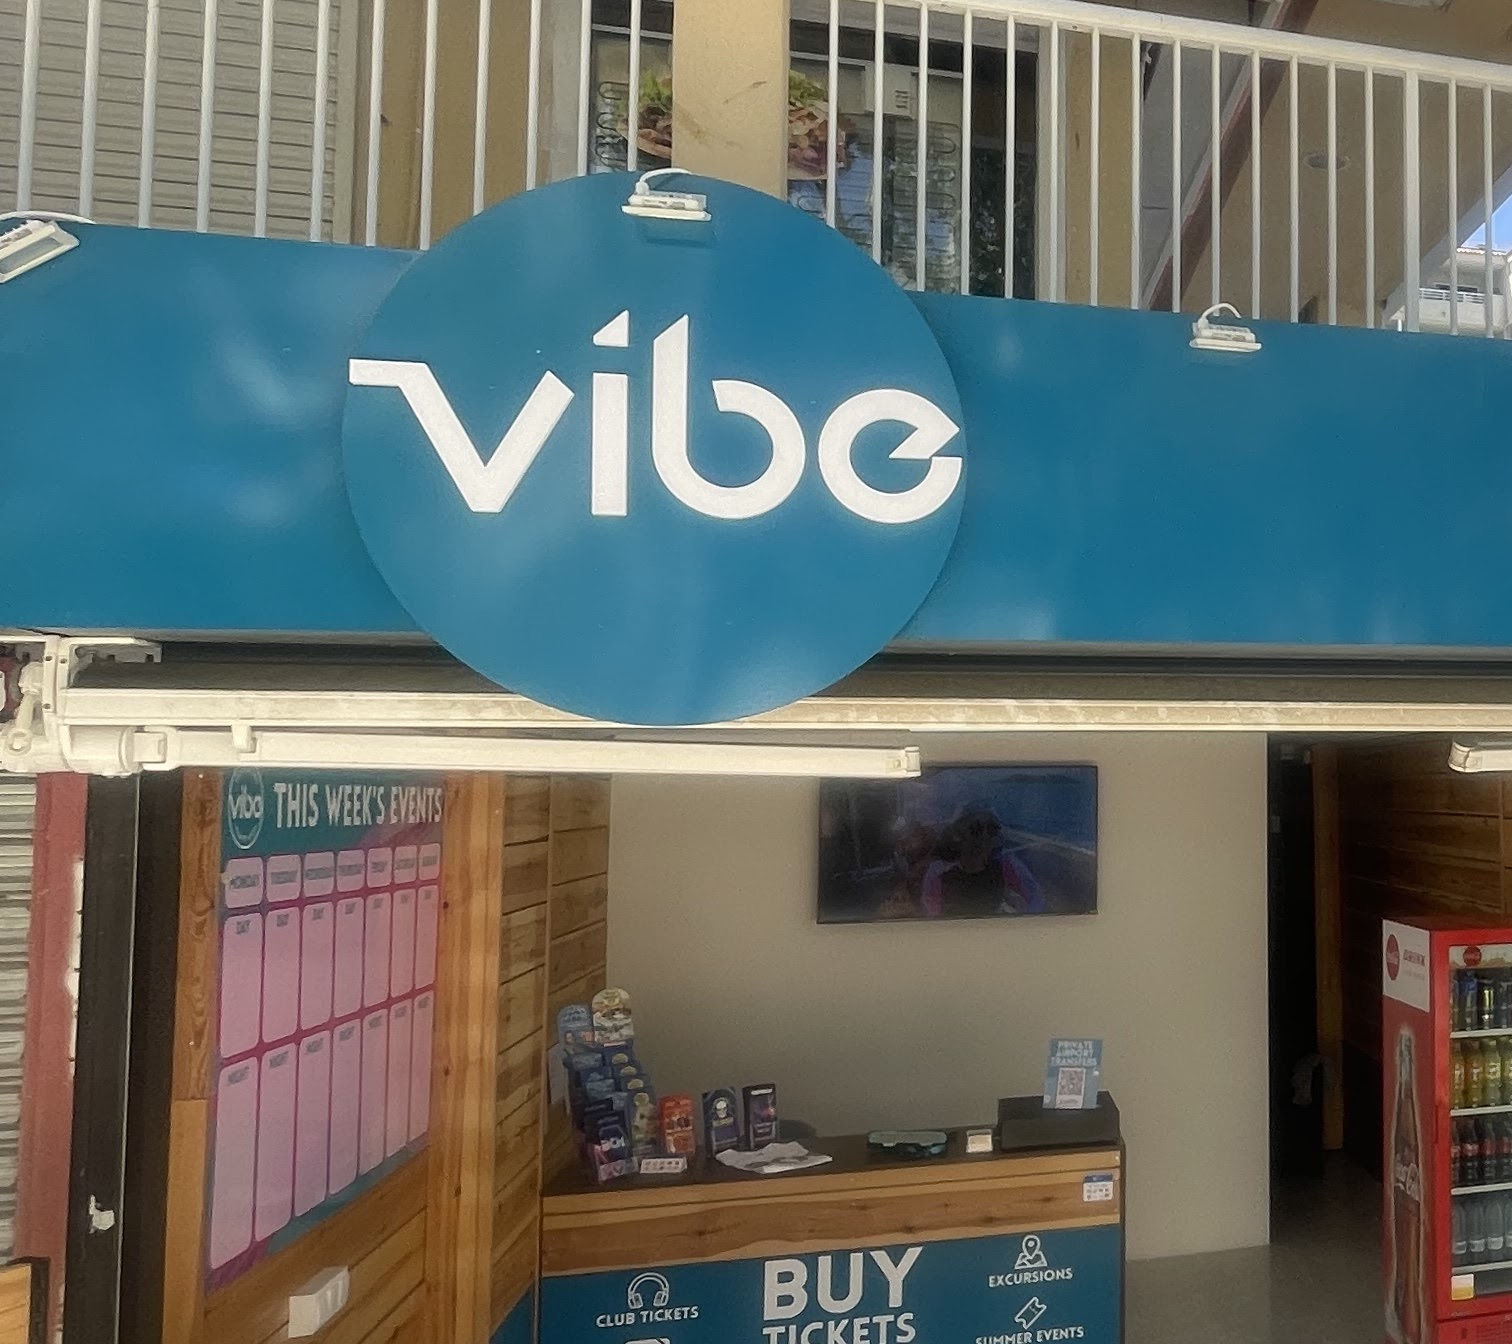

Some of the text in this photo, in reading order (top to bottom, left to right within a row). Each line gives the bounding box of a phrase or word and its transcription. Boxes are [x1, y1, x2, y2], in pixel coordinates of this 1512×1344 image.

[349, 310, 962, 523] vibe
[273, 783, 443, 828] THIS WEEK'S EVENTS
[763, 1246, 923, 1321] BUY
[988, 1268, 1073, 1287] EXCURSIONS
[596, 1306, 699, 1327] CLUB TICKETS
[1036, 1326, 1084, 1343] EVENTS
